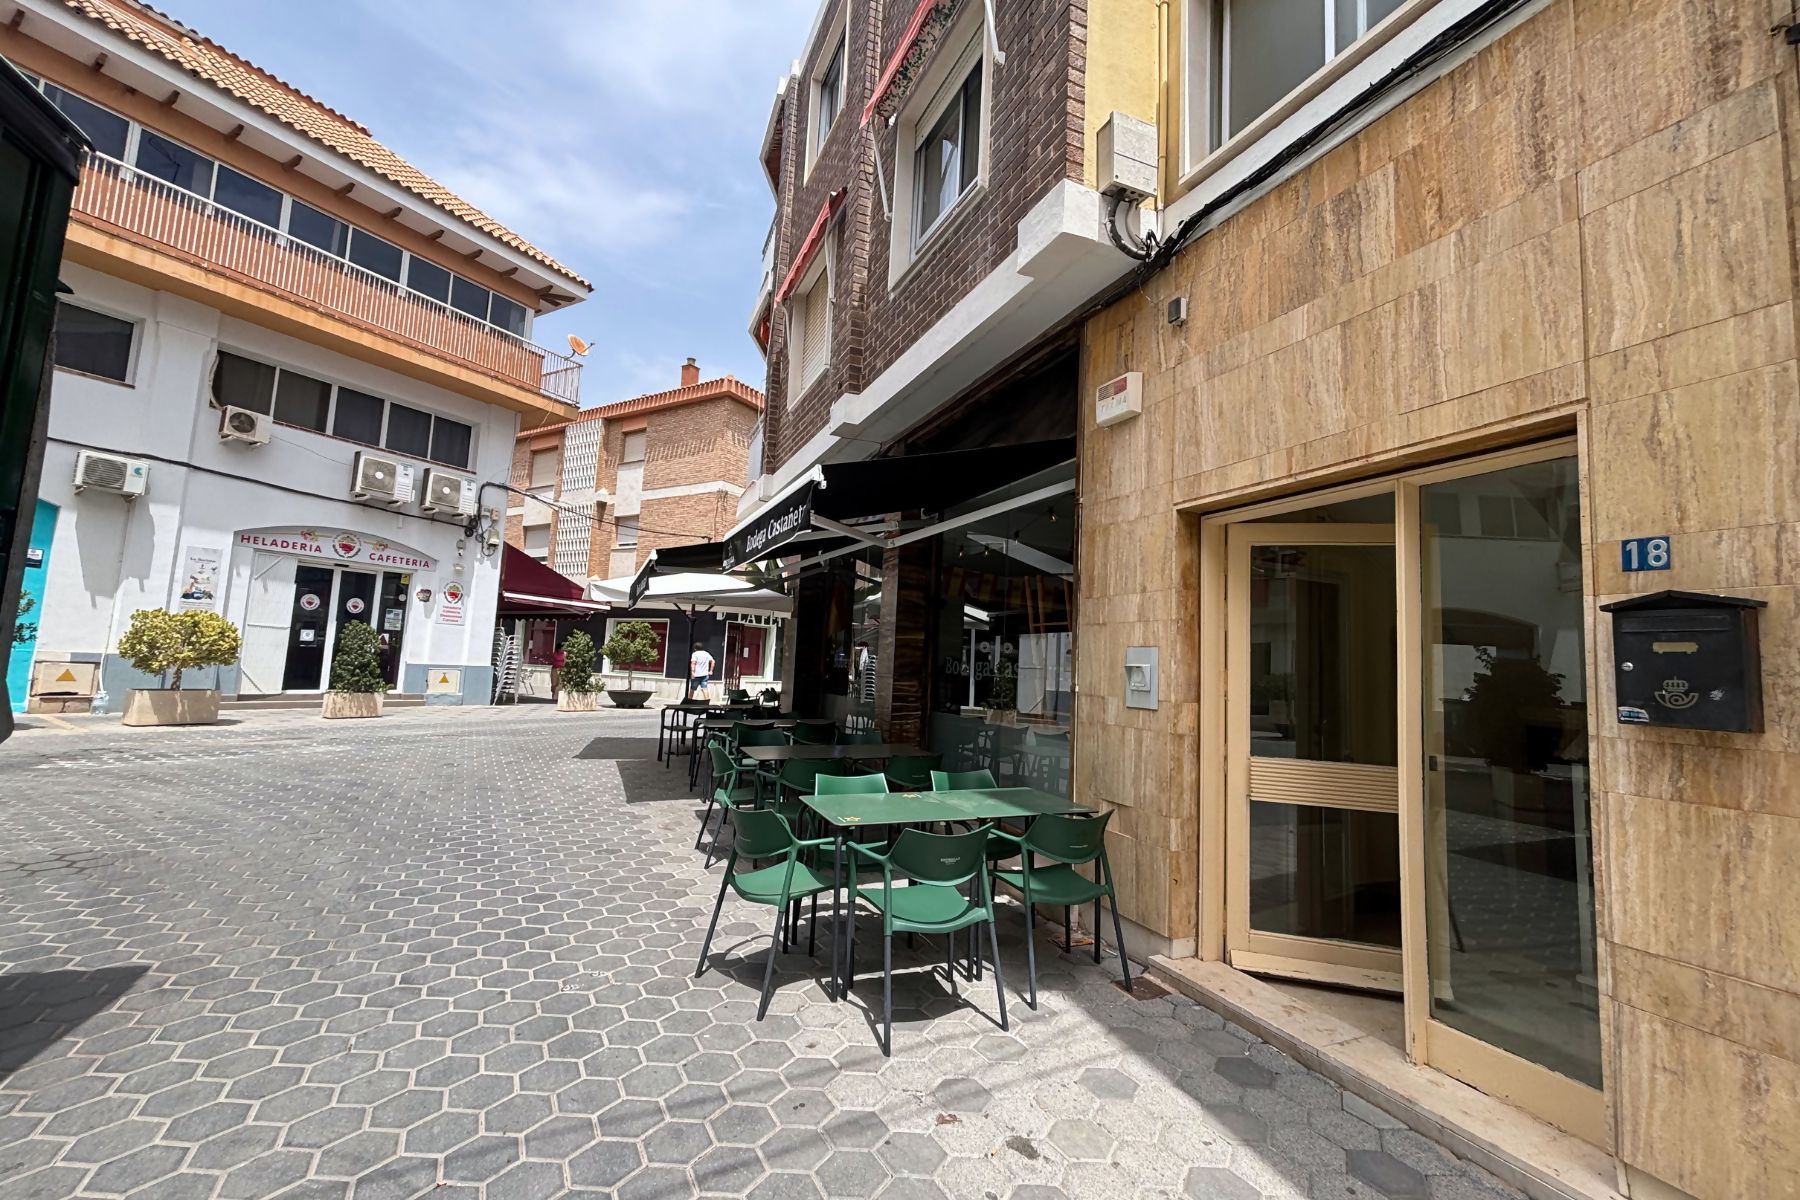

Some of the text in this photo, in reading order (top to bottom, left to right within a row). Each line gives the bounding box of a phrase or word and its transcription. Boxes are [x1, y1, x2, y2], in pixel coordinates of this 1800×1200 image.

[240, 534, 322, 554] HELADERIA
[369, 552, 430, 569] CAFETERIA
[746, 528, 767, 553] Bodega
[1625, 539, 1668, 569] 18
